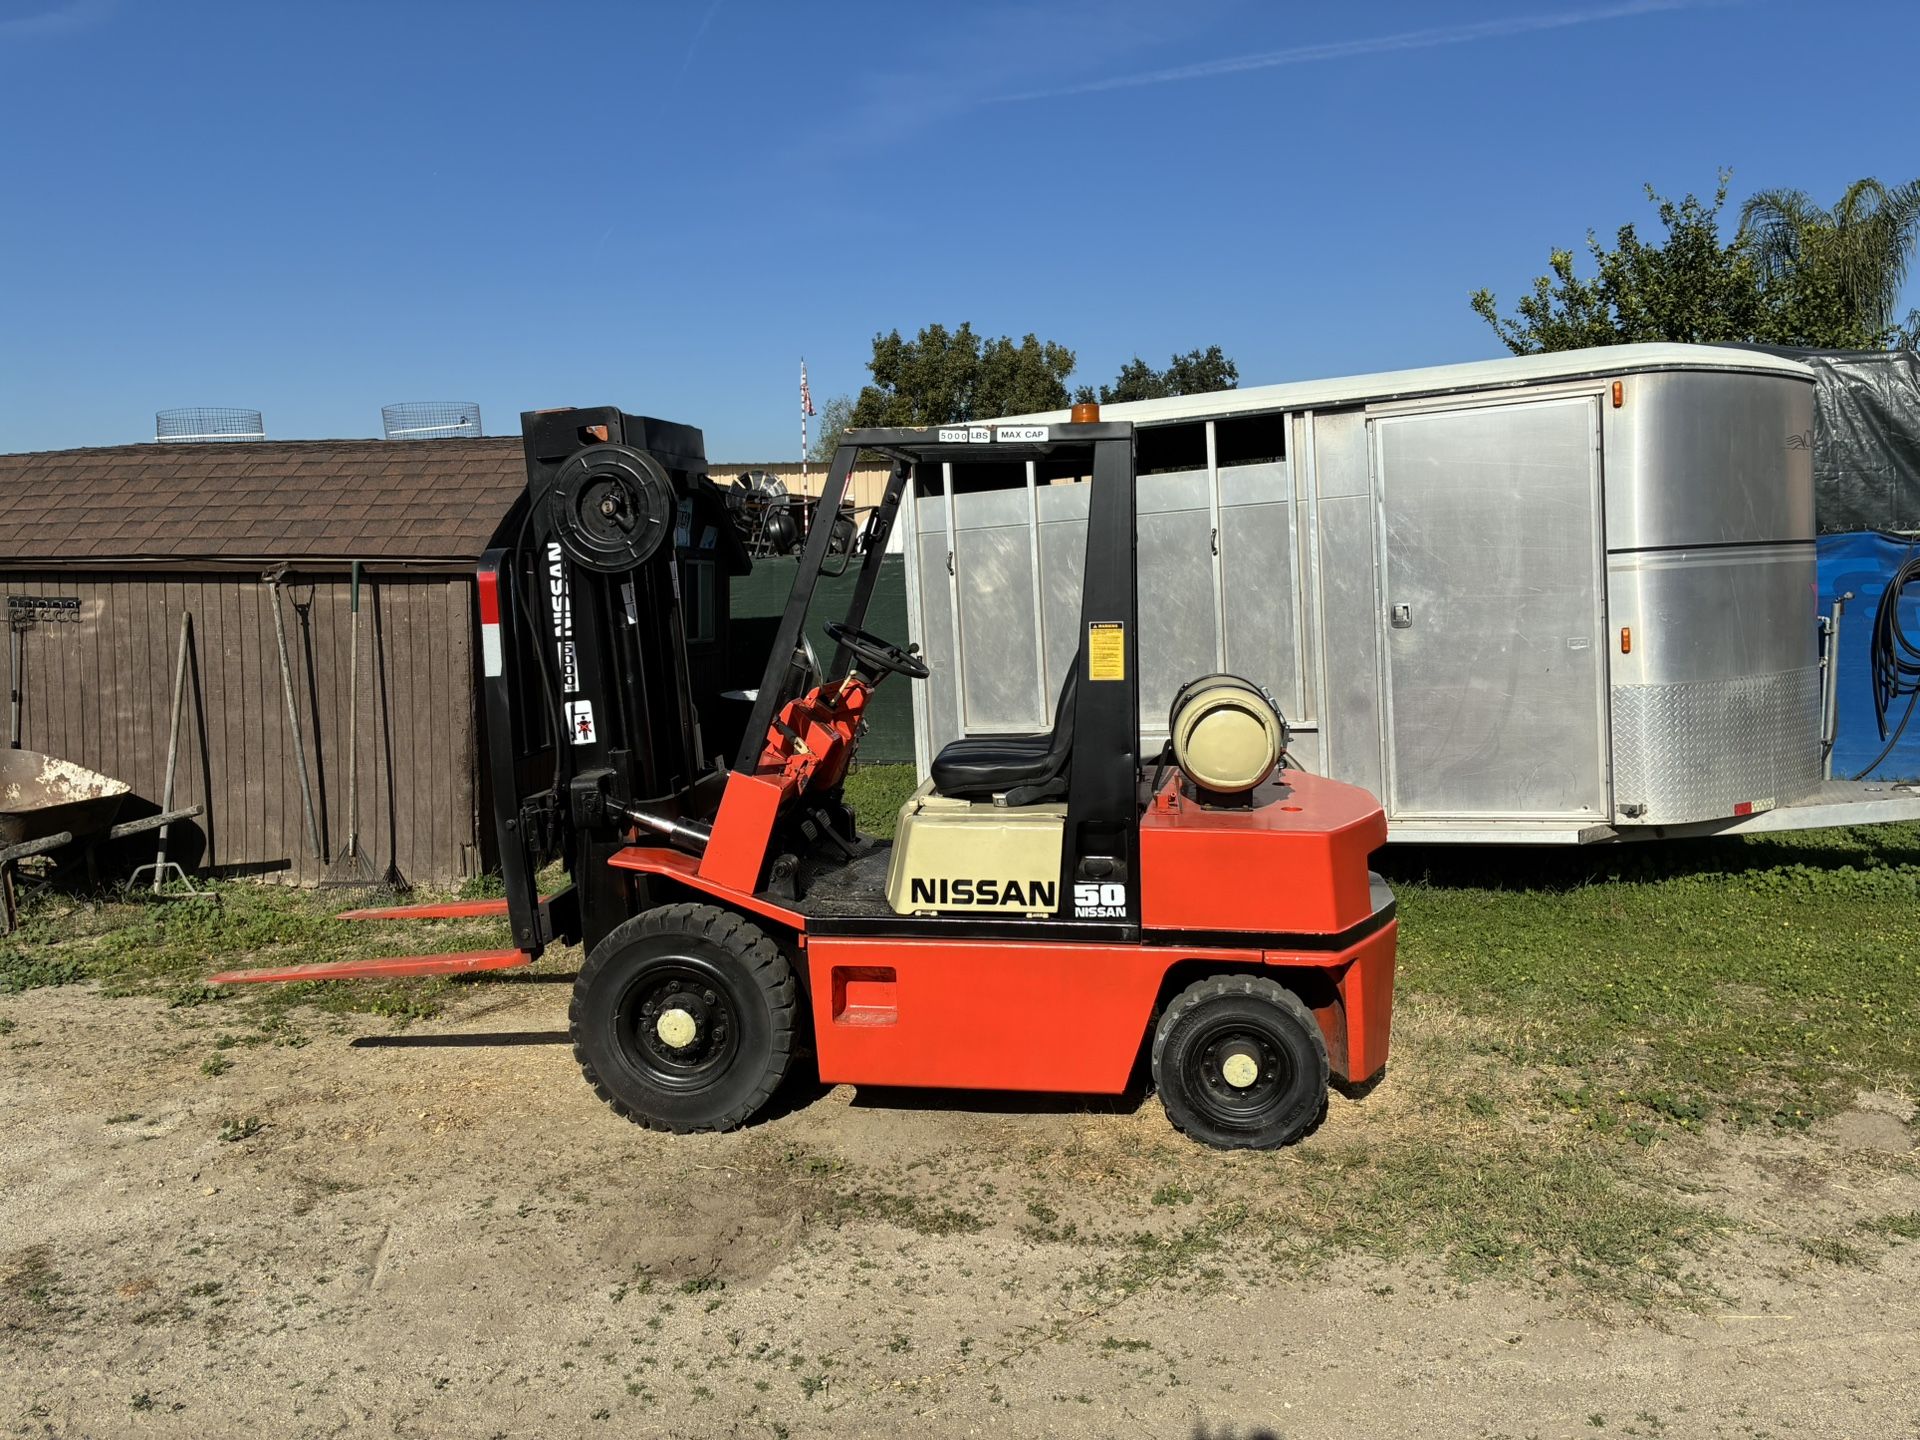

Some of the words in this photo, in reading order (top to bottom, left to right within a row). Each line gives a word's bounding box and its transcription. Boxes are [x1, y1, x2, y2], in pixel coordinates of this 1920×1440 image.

[941, 432, 967, 440] 5000
[547, 543, 572, 637] NISSAN
[911, 878, 1055, 907] NISSAN
[1073, 884, 1126, 906] 50
[1075, 906, 1126, 918] NISSAN
